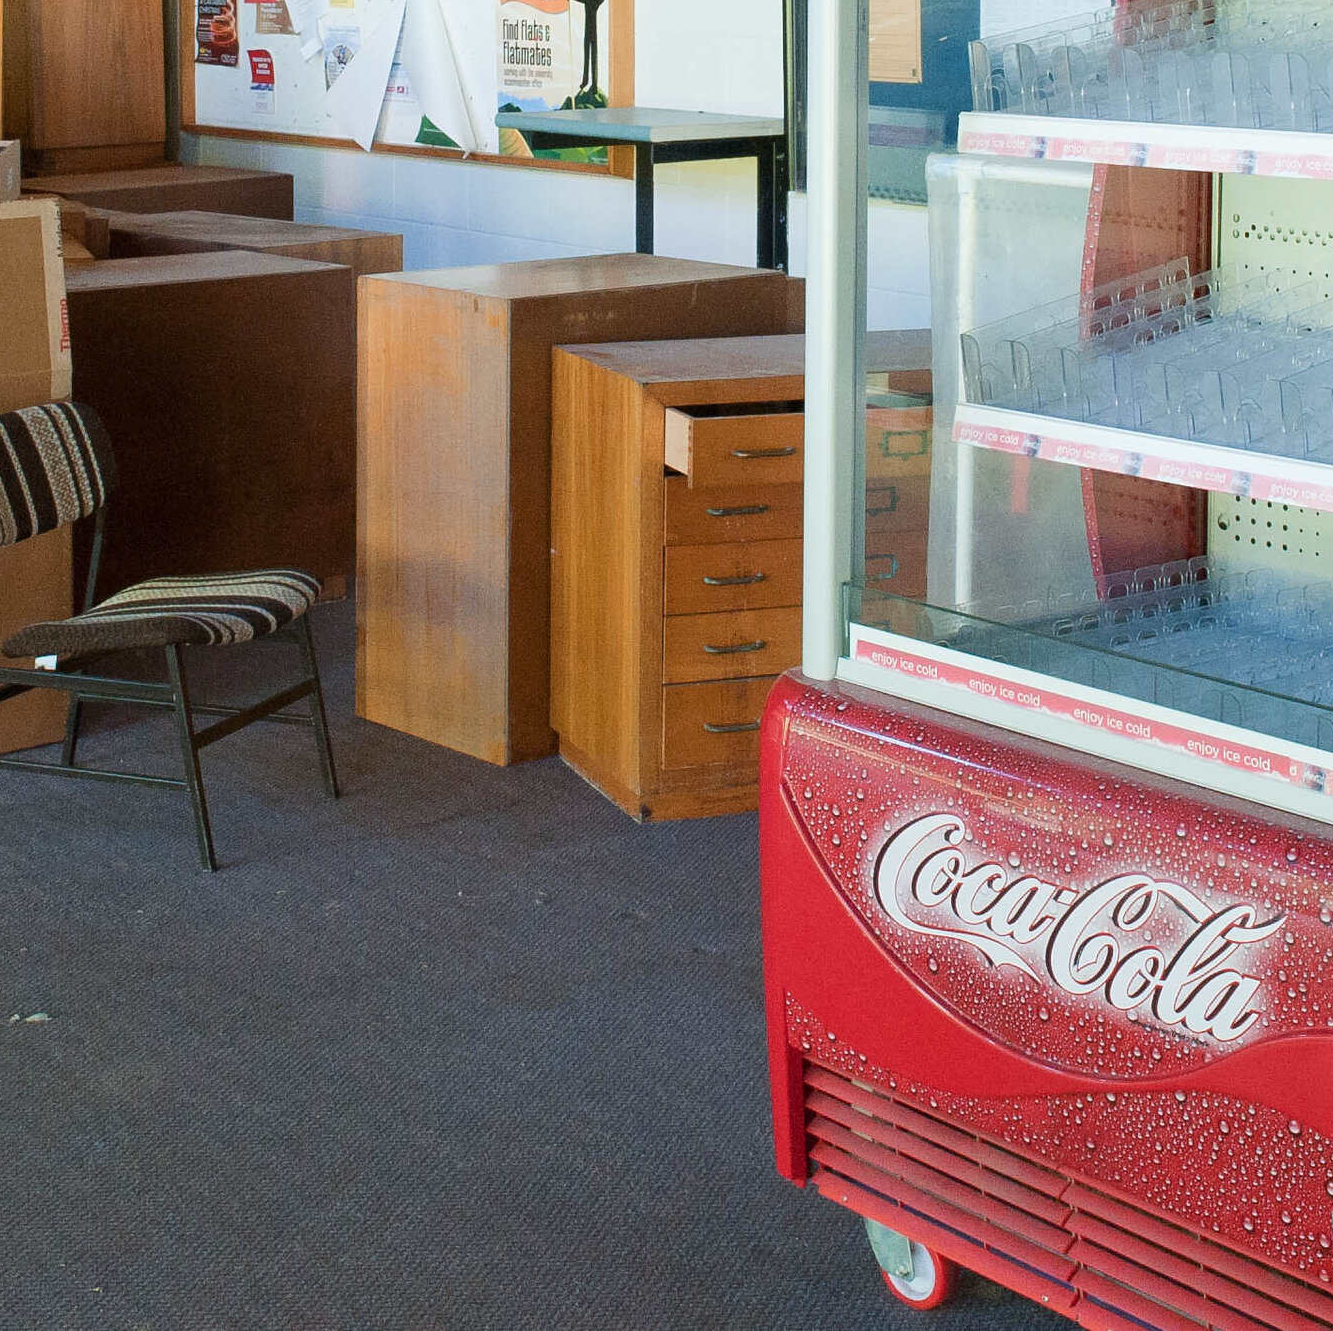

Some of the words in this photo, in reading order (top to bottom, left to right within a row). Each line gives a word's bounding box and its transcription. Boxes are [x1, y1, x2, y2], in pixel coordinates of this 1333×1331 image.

[521, 19, 544, 42] flats
[503, 41, 552, 67] flatmates
[960, 428, 984, 442] enjoy
[985, 430, 998, 441] ice
[999, 433, 1019, 445] cold
[1056, 444, 1082, 459] enjoy
[1159, 462, 1185, 478] enjoy
[1186, 466, 1202, 478] ice
[1204, 470, 1227, 484] cold
[1270, 482, 1299, 498] enjoy
[1301, 487, 1317, 500] ice
[871, 650, 899, 669] enjoy
[899, 658, 915, 672] ice
[916, 661, 938, 678] cold
[969, 677, 997, 698] enjoy
[999, 684, 1015, 699] ice
[1017, 689, 1041, 707] cold
[1073, 706, 1104, 728] enjoy
[1106, 714, 1123, 730] ice
[1125, 719, 1151, 738] cold
[1187, 738, 1219, 760] enjoy
[1222, 746, 1241, 763] ice
[1244, 751, 1271, 771] cold
[872, 812, 1287, 1043] Coca-Cola
